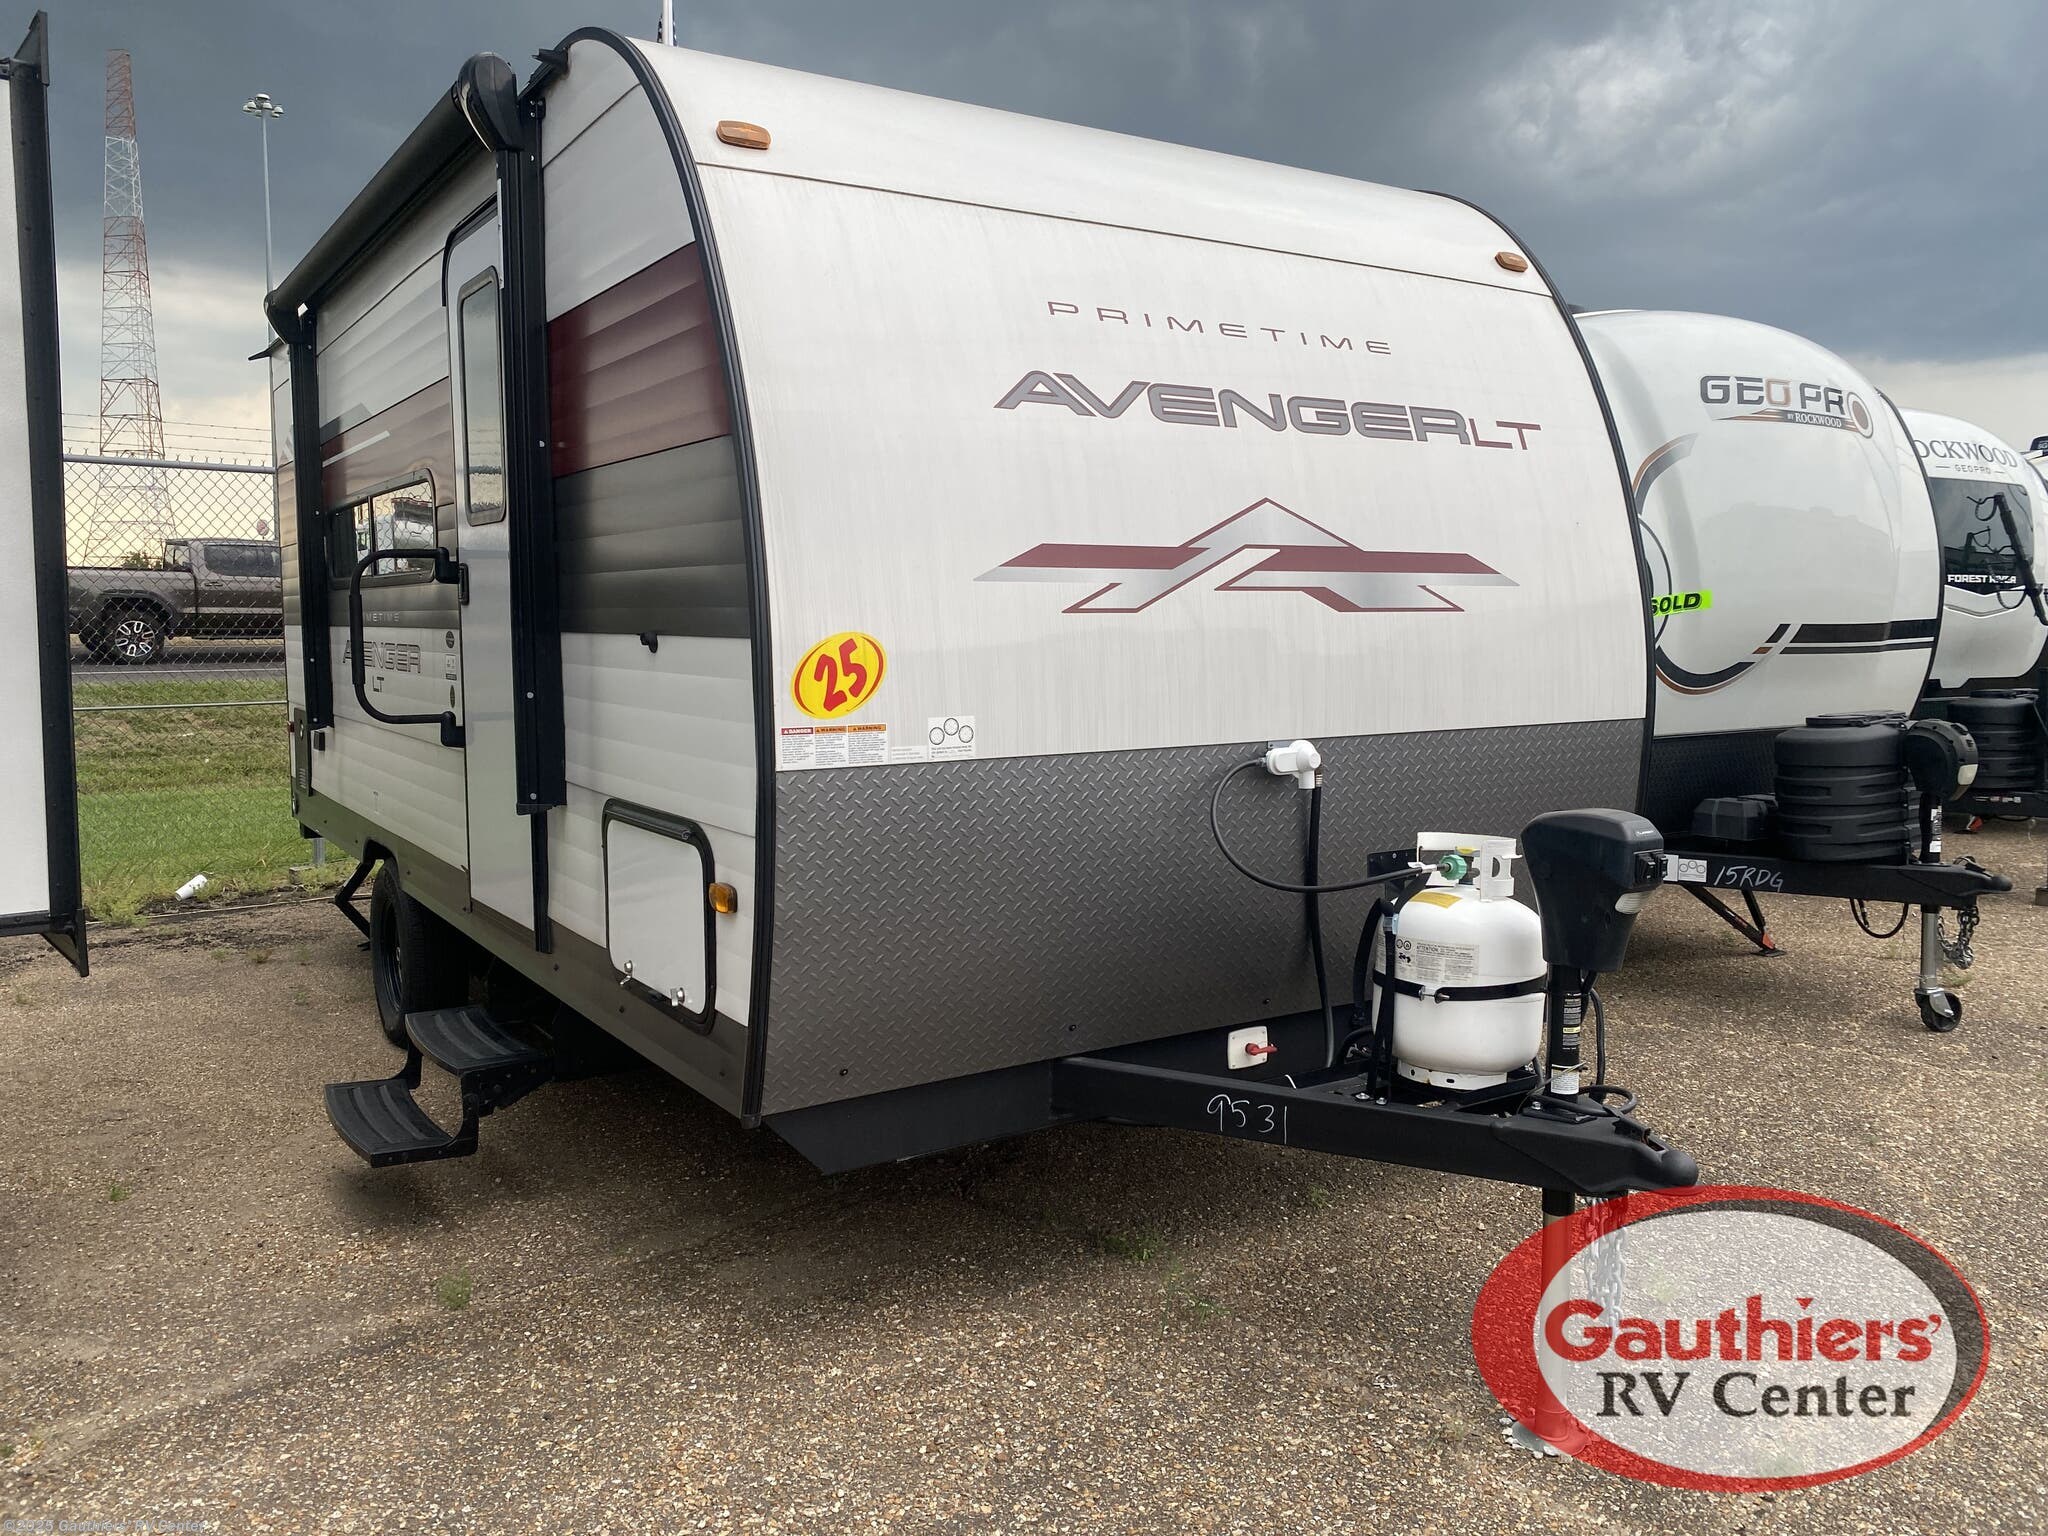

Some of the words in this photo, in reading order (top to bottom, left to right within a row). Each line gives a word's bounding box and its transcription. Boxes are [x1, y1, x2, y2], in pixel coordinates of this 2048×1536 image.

[1047, 301, 1392, 355] PRIMETIME
[1795, 412, 1842, 428] ROCKWOOD
[1913, 439, 2018, 468] OCKWOOD
[1947, 574, 1988, 583] FOREST
[814, 638, 867, 712] 25
[1206, 1093, 1288, 1145] 9531
